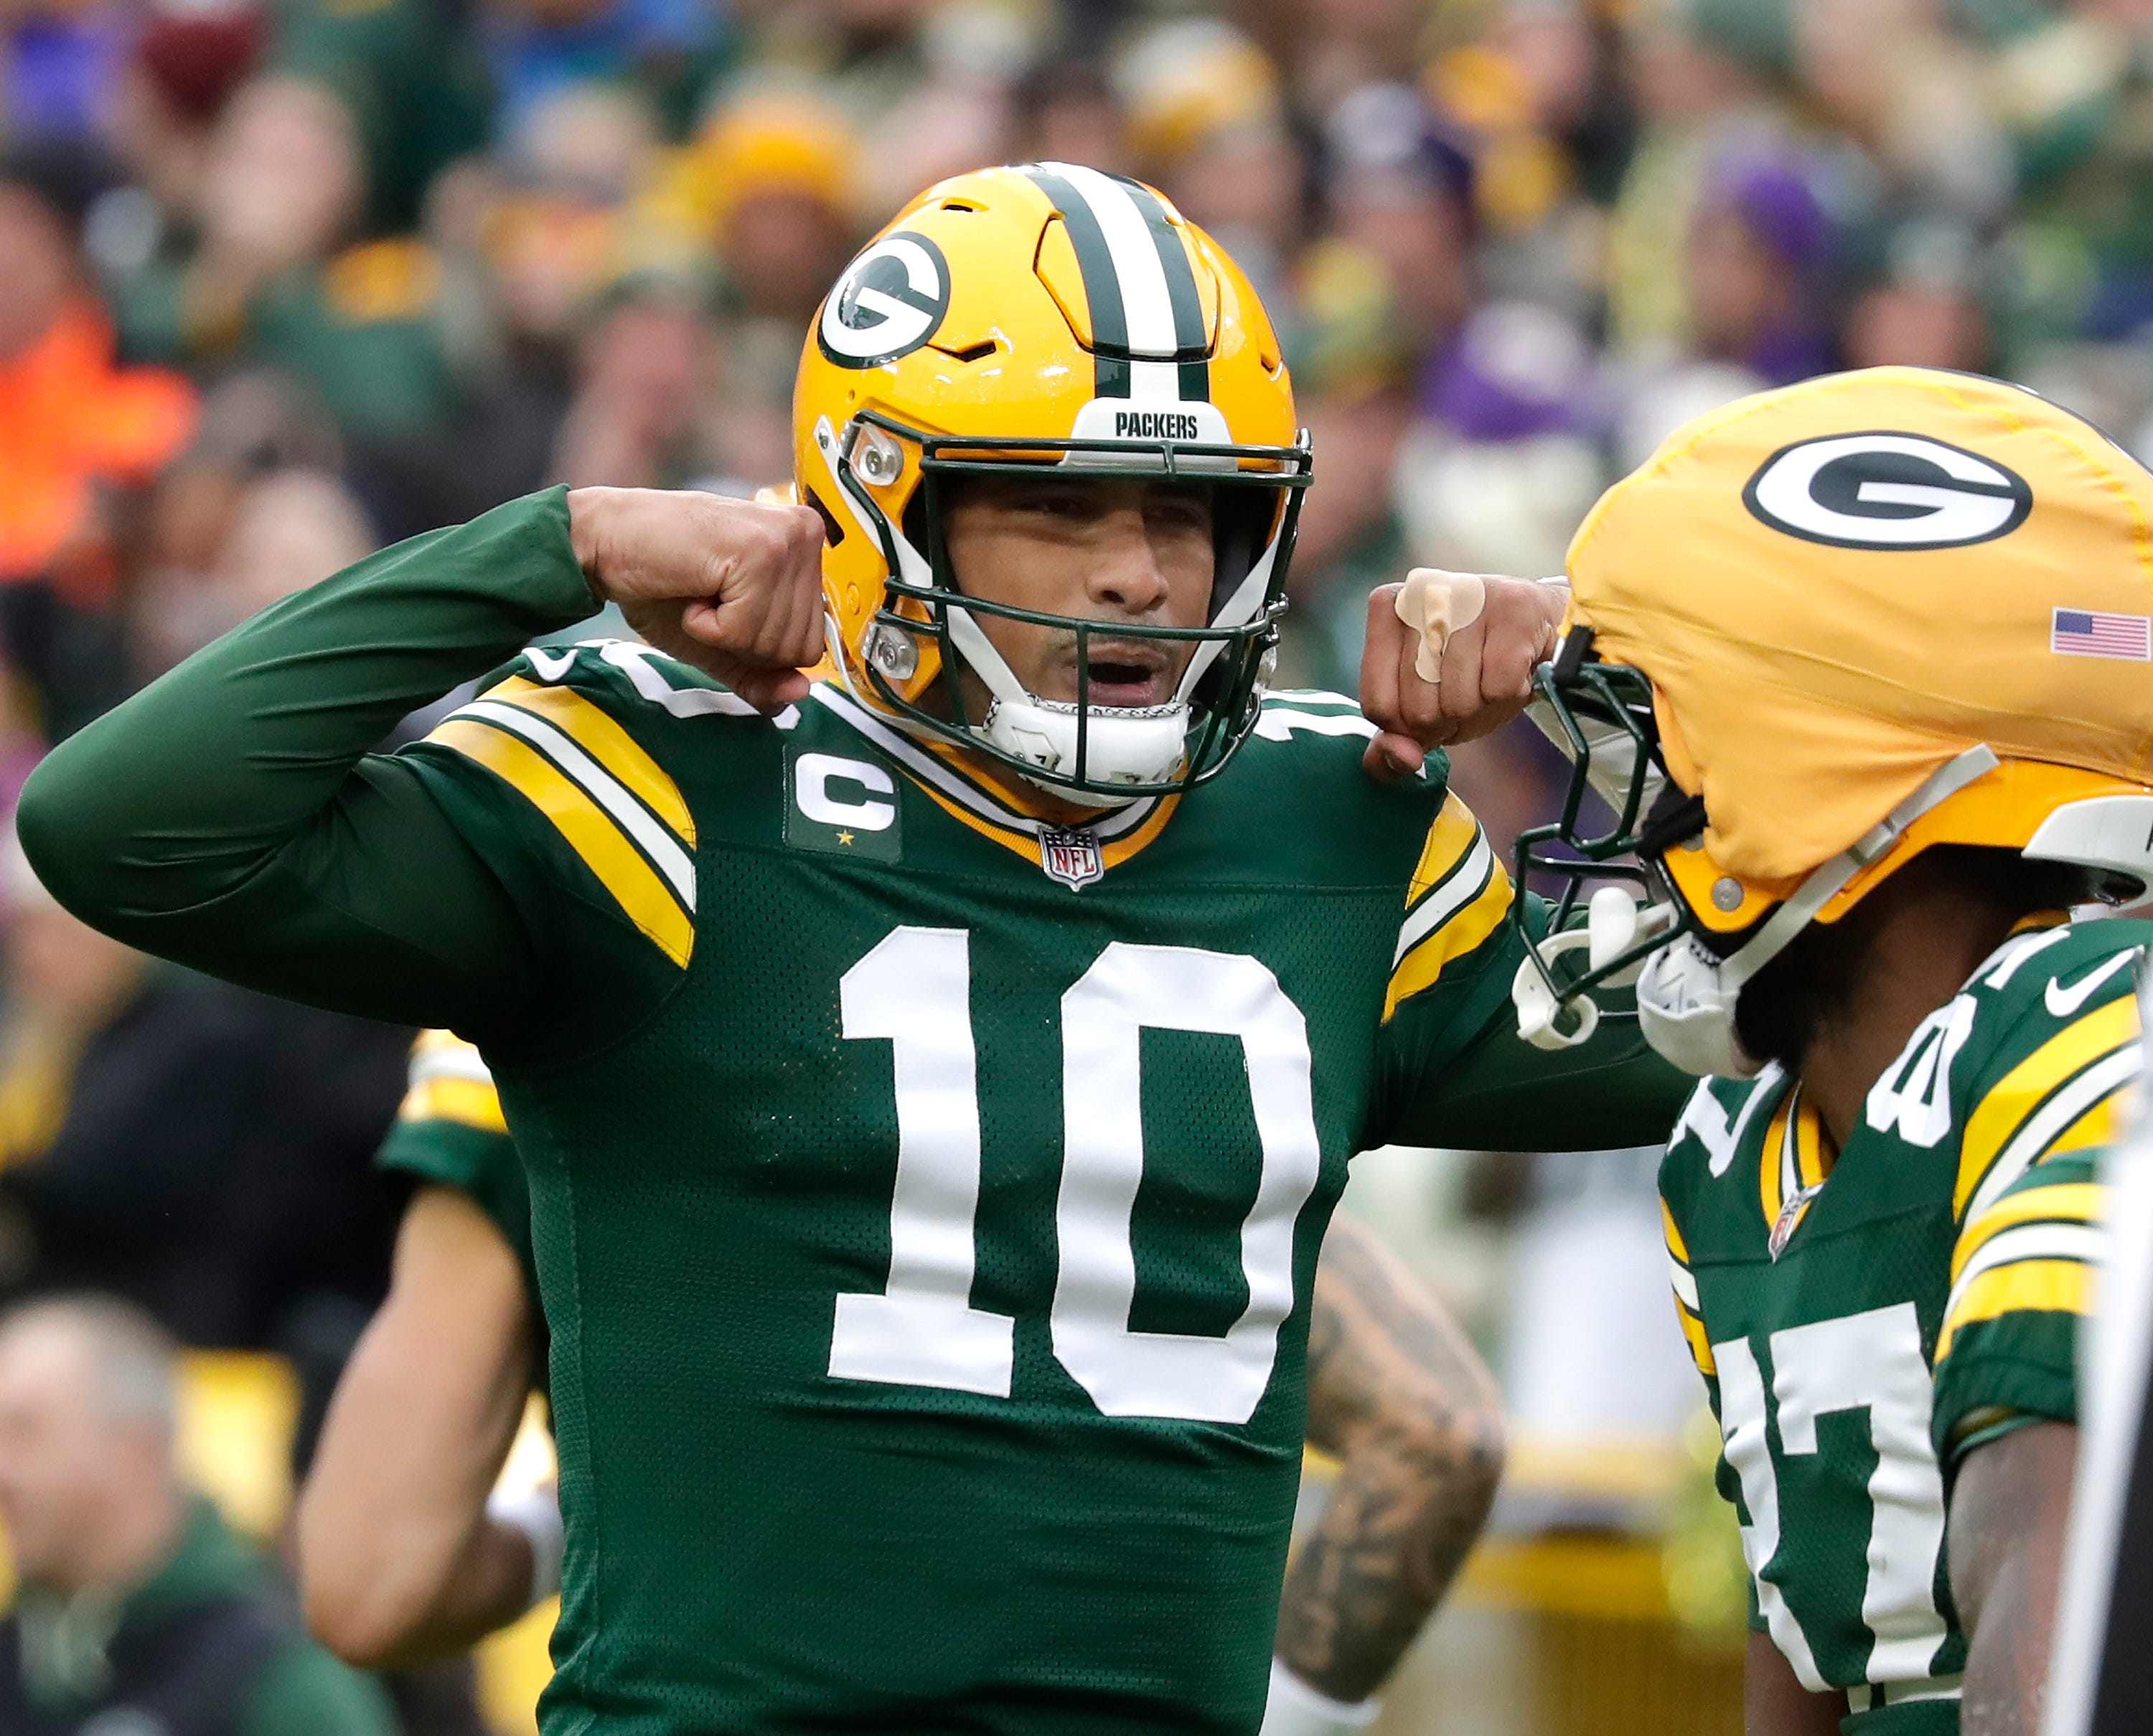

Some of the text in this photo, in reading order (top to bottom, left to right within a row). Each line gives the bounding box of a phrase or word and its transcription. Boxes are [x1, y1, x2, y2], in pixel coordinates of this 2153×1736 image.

[821, 236, 940, 357] G
[1116, 412, 1197, 439] PACKERS
[1755, 433, 2016, 544] G
[794, 752, 896, 832] C
[1053, 848, 1094, 876] NFL
[827, 924, 1321, 1425] 10
